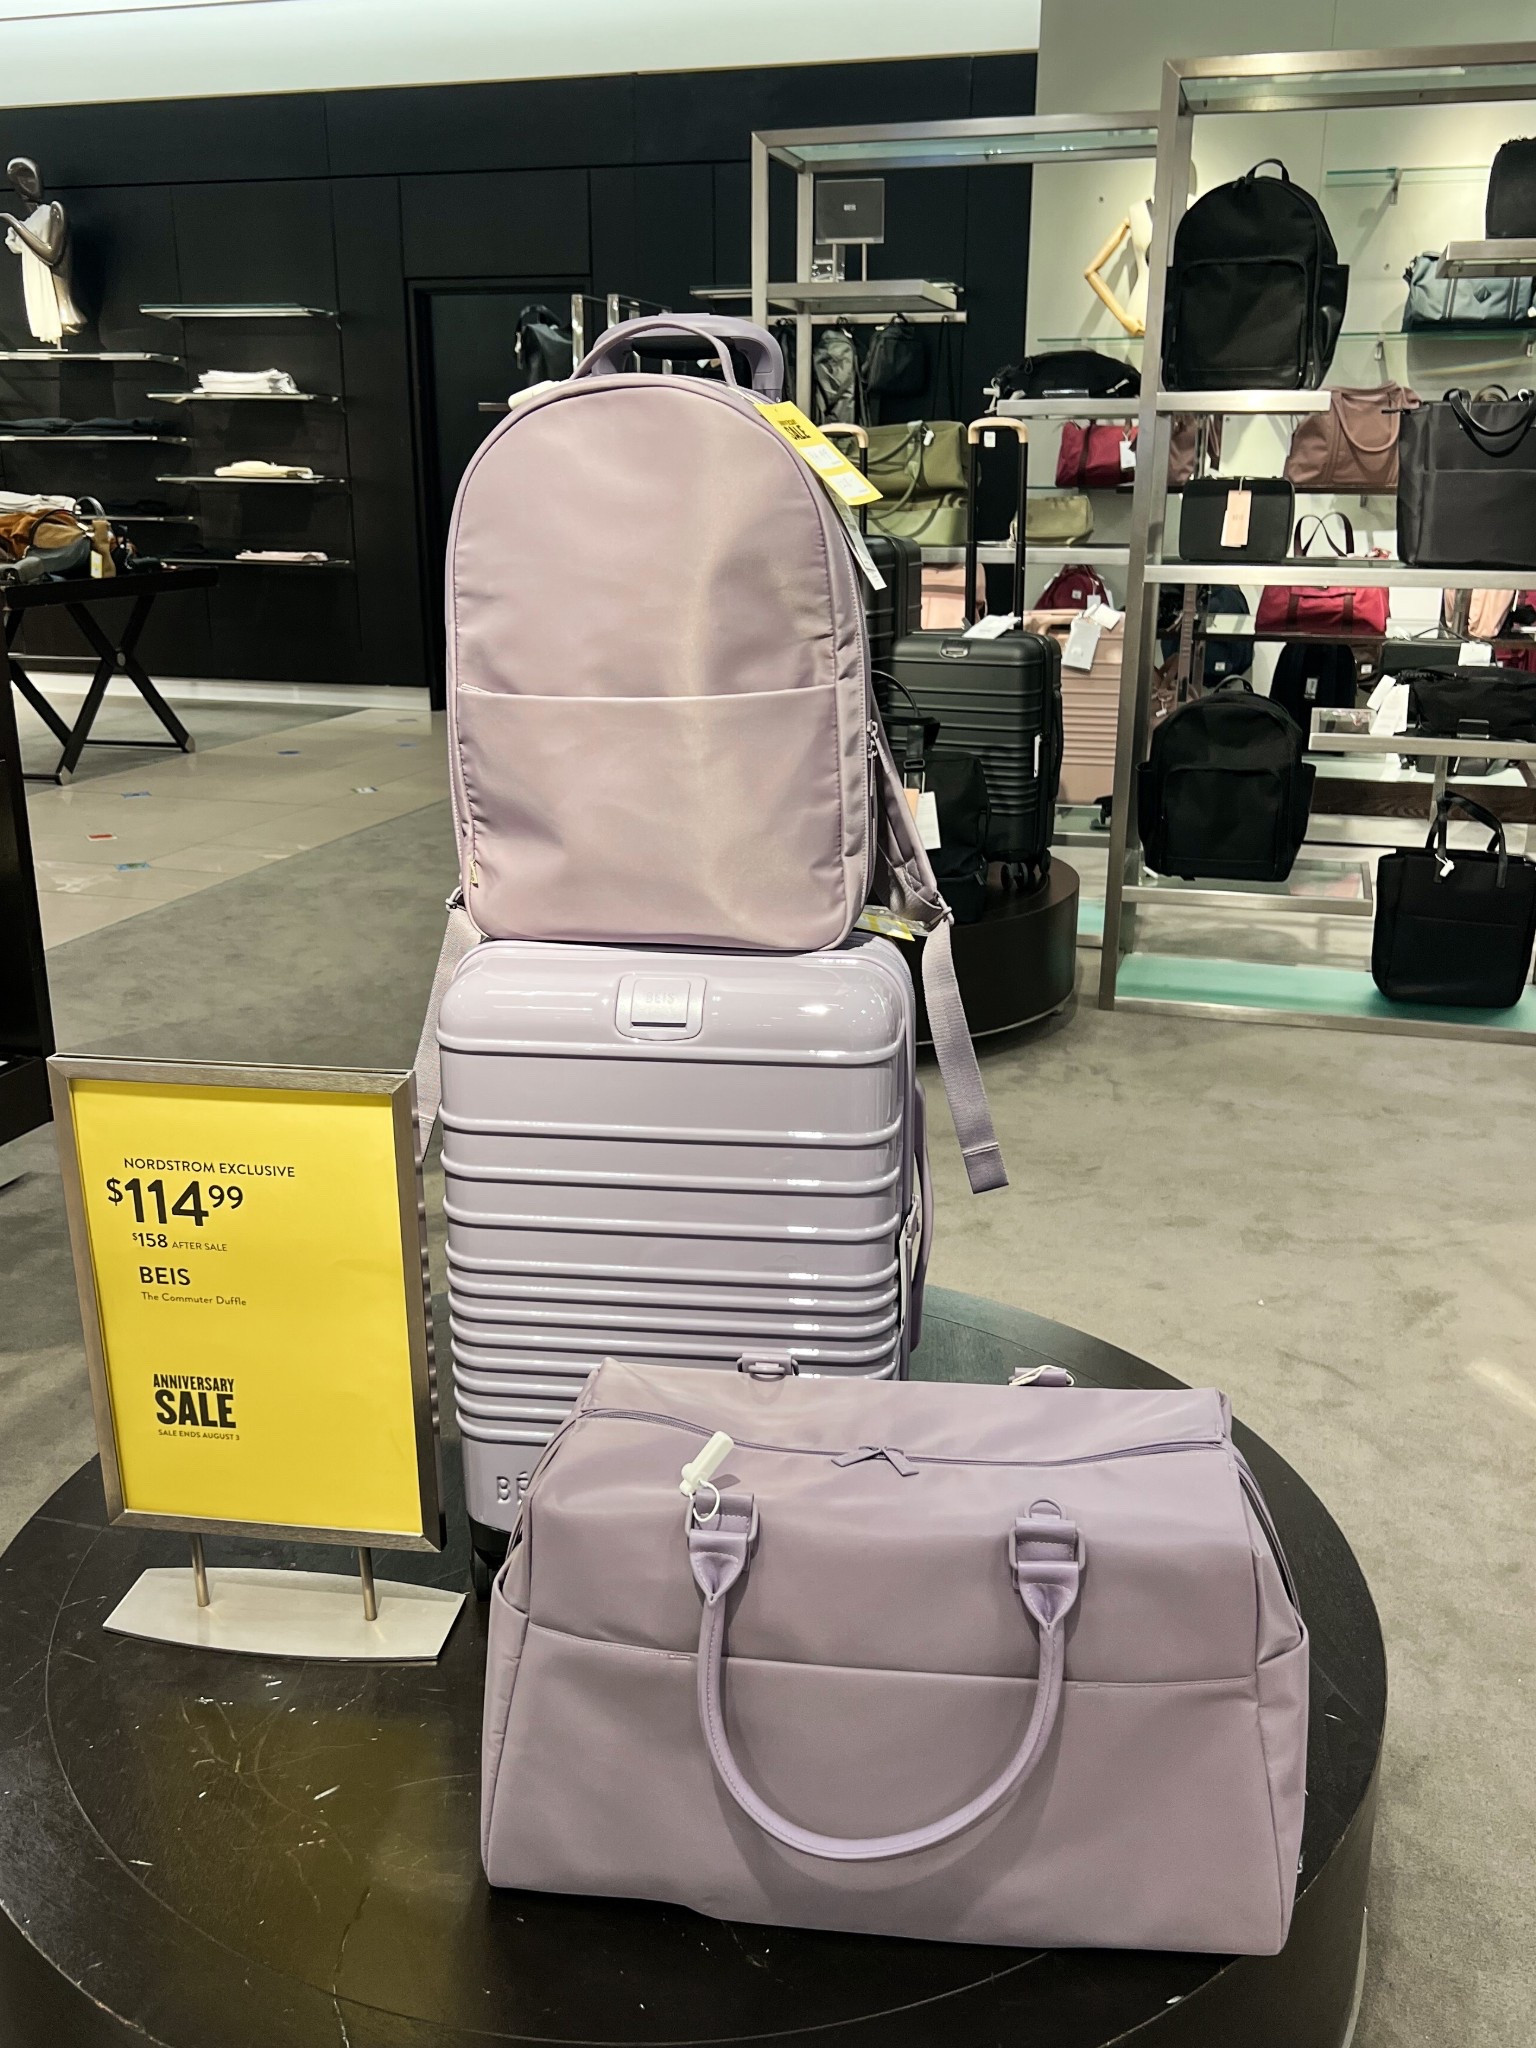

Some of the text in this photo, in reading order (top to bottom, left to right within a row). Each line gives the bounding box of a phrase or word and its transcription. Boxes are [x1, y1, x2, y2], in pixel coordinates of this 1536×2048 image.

[124, 1157, 295, 1178] NORDSTROM EXCLUSIVE
[132, 1232, 228, 1251] $158 AFTER SALE
[139, 1266, 191, 1286] BEIS
[141, 1291, 247, 1306] The Commuter Duffle
[153, 1373, 234, 1392] ANNIVERSARY
[155, 1389, 236, 1428] SALE
[178, 1430, 200, 1438] ENDS
[202, 1432, 234, 1440] AUGUST
[496, 1471, 528, 1504] BÉ
